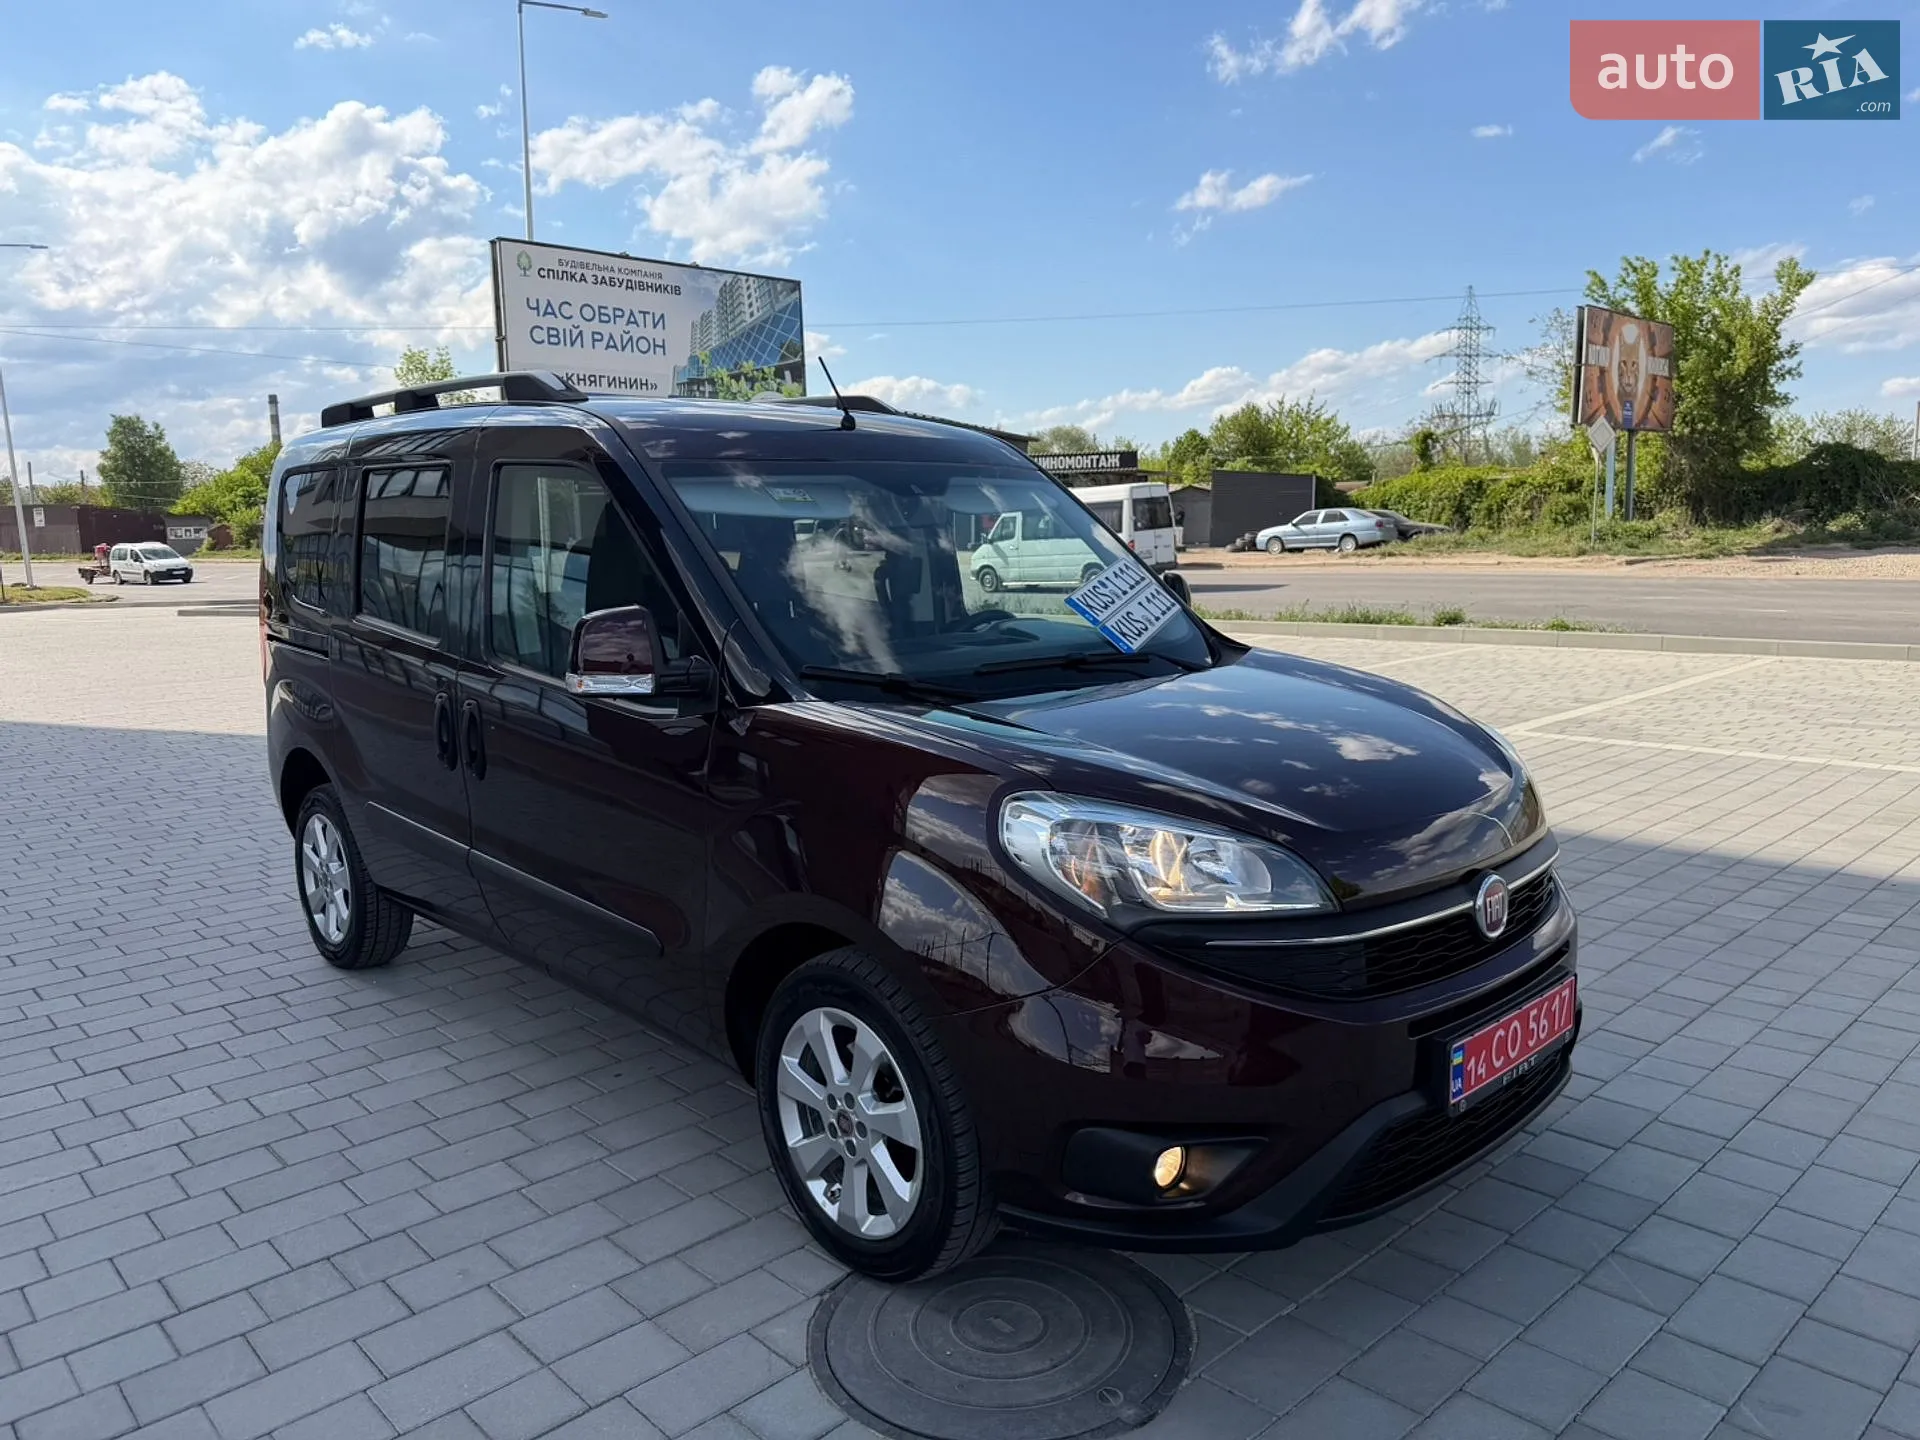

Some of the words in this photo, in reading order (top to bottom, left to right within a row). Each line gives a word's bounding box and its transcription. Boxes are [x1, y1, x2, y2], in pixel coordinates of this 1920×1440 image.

[537, 267, 588, 284] СПІЛКА
[591, 274, 682, 296] ЗАБУДІВНИКІВ
[557, 258, 615, 274] БУДІВЕЛЬНА
[617, 267, 663, 280] КОМПАНІЯ
[526, 297, 574, 320] ЧАС
[579, 303, 666, 331] ОБРАТИ
[529, 324, 584, 349] СВІЙ
[591, 329, 666, 356] РАЙОН
[1076, 584, 1116, 617] KUS
[1110, 611, 1149, 646] KUS
[1486, 892, 1503, 924] FIAT
[1467, 1050, 1487, 1086] 14
[1492, 1020, 1522, 1069] CO
[1528, 987, 1570, 1047] 5617
